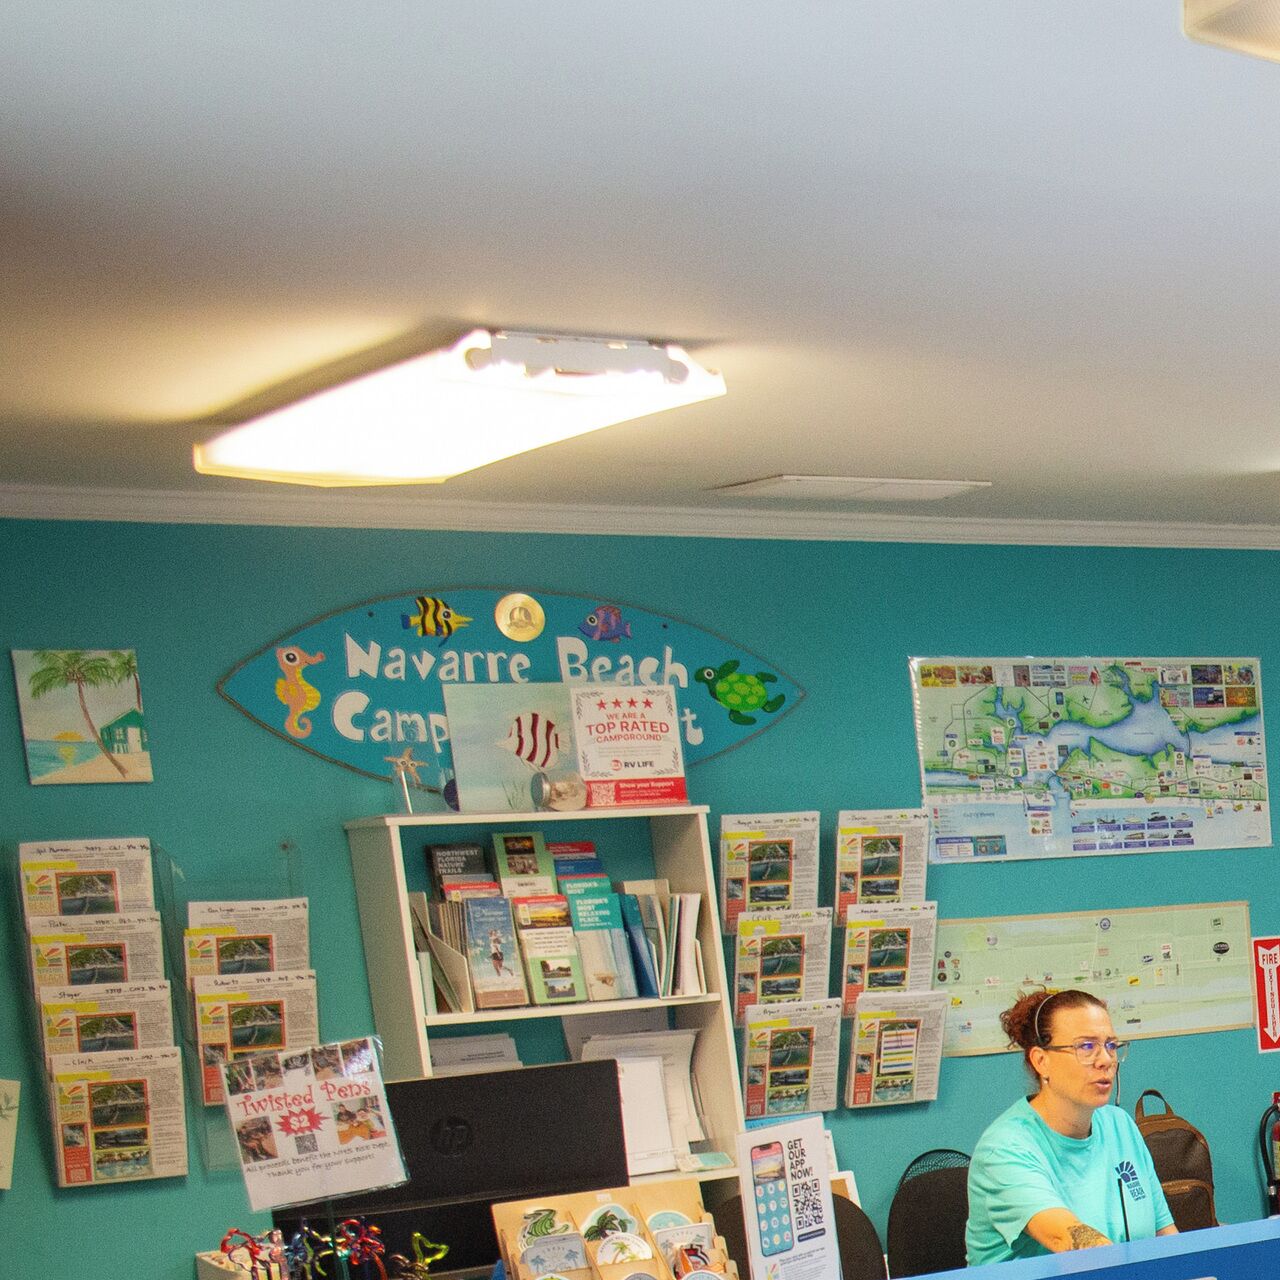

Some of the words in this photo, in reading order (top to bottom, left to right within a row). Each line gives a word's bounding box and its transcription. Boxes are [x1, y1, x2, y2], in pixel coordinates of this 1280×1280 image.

[345, 632, 530, 683] Navarre
[557, 637, 688, 688] Beach
[606, 713, 619, 721] WE
[622, 712, 638, 720] ARE
[586, 721, 616, 736] TOP
[620, 721, 670, 734] RATED
[596, 733, 662, 743] CAMPGROUND
[624, 761, 636, 769] RV
[638, 760, 654, 768] LIFE
[436, 848, 478, 858] NORTHWEST
[437, 856, 467, 864] FLORIDA
[438, 867, 463, 875] TRAILS
[1262, 953, 1278, 965] FIRE
[1268, 968, 1277, 1037] EXTINGUISHER
[237, 1085, 314, 1117] Twisted
[320, 1081, 371, 1101] Pens
[289, 1115, 311, 1130] $2
[788, 1138, 803, 1150] GET
[789, 1149, 806, 1160] OUR
[790, 1159, 805, 1170] APP
[791, 1166, 813, 1181] NOW!
